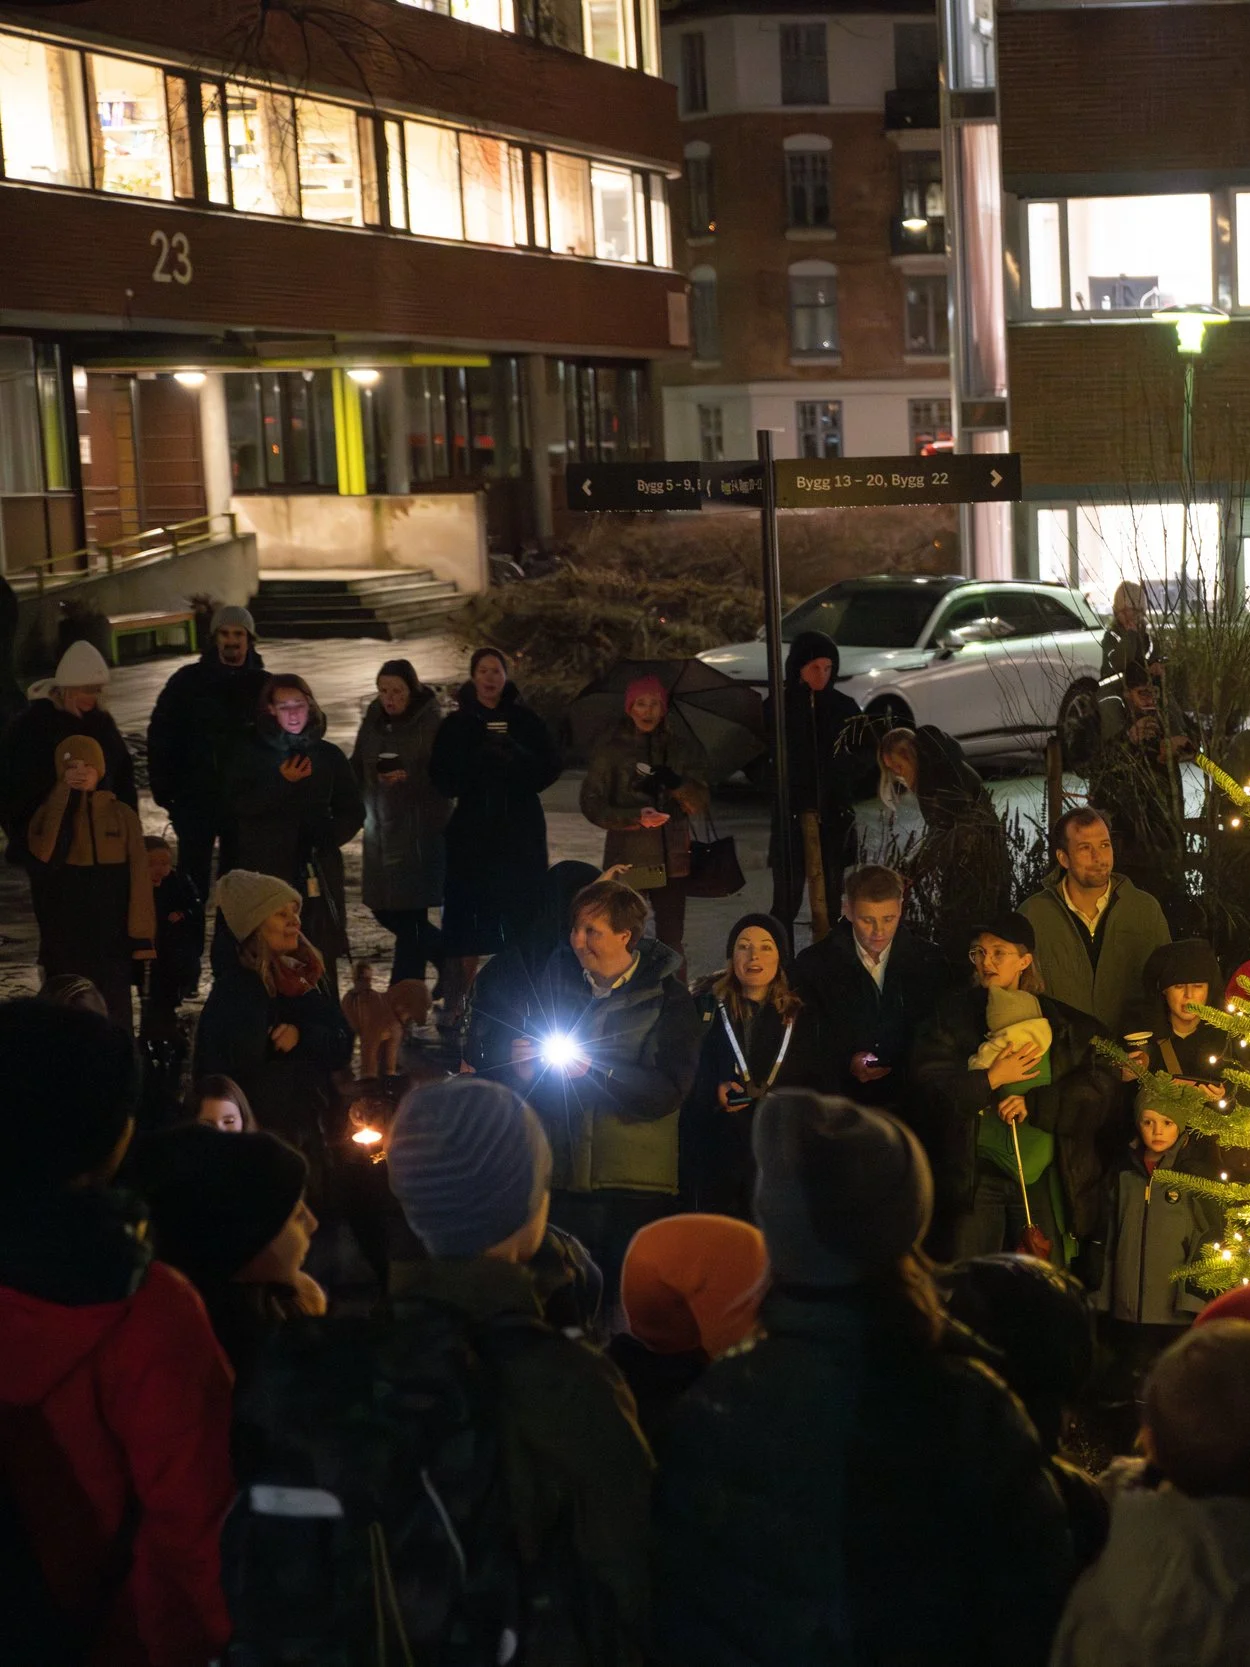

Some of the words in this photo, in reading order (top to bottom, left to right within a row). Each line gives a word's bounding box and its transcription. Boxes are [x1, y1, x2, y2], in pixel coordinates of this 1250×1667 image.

[150, 230, 192, 285] 23
[636, 478, 665, 495] Bygg
[796, 475, 831, 491] Bygg
[834, 475, 852, 488] 13
[866, 474, 888, 488] 20,
[891, 473, 925, 489] Bygg
[931, 472, 949, 485] 22
